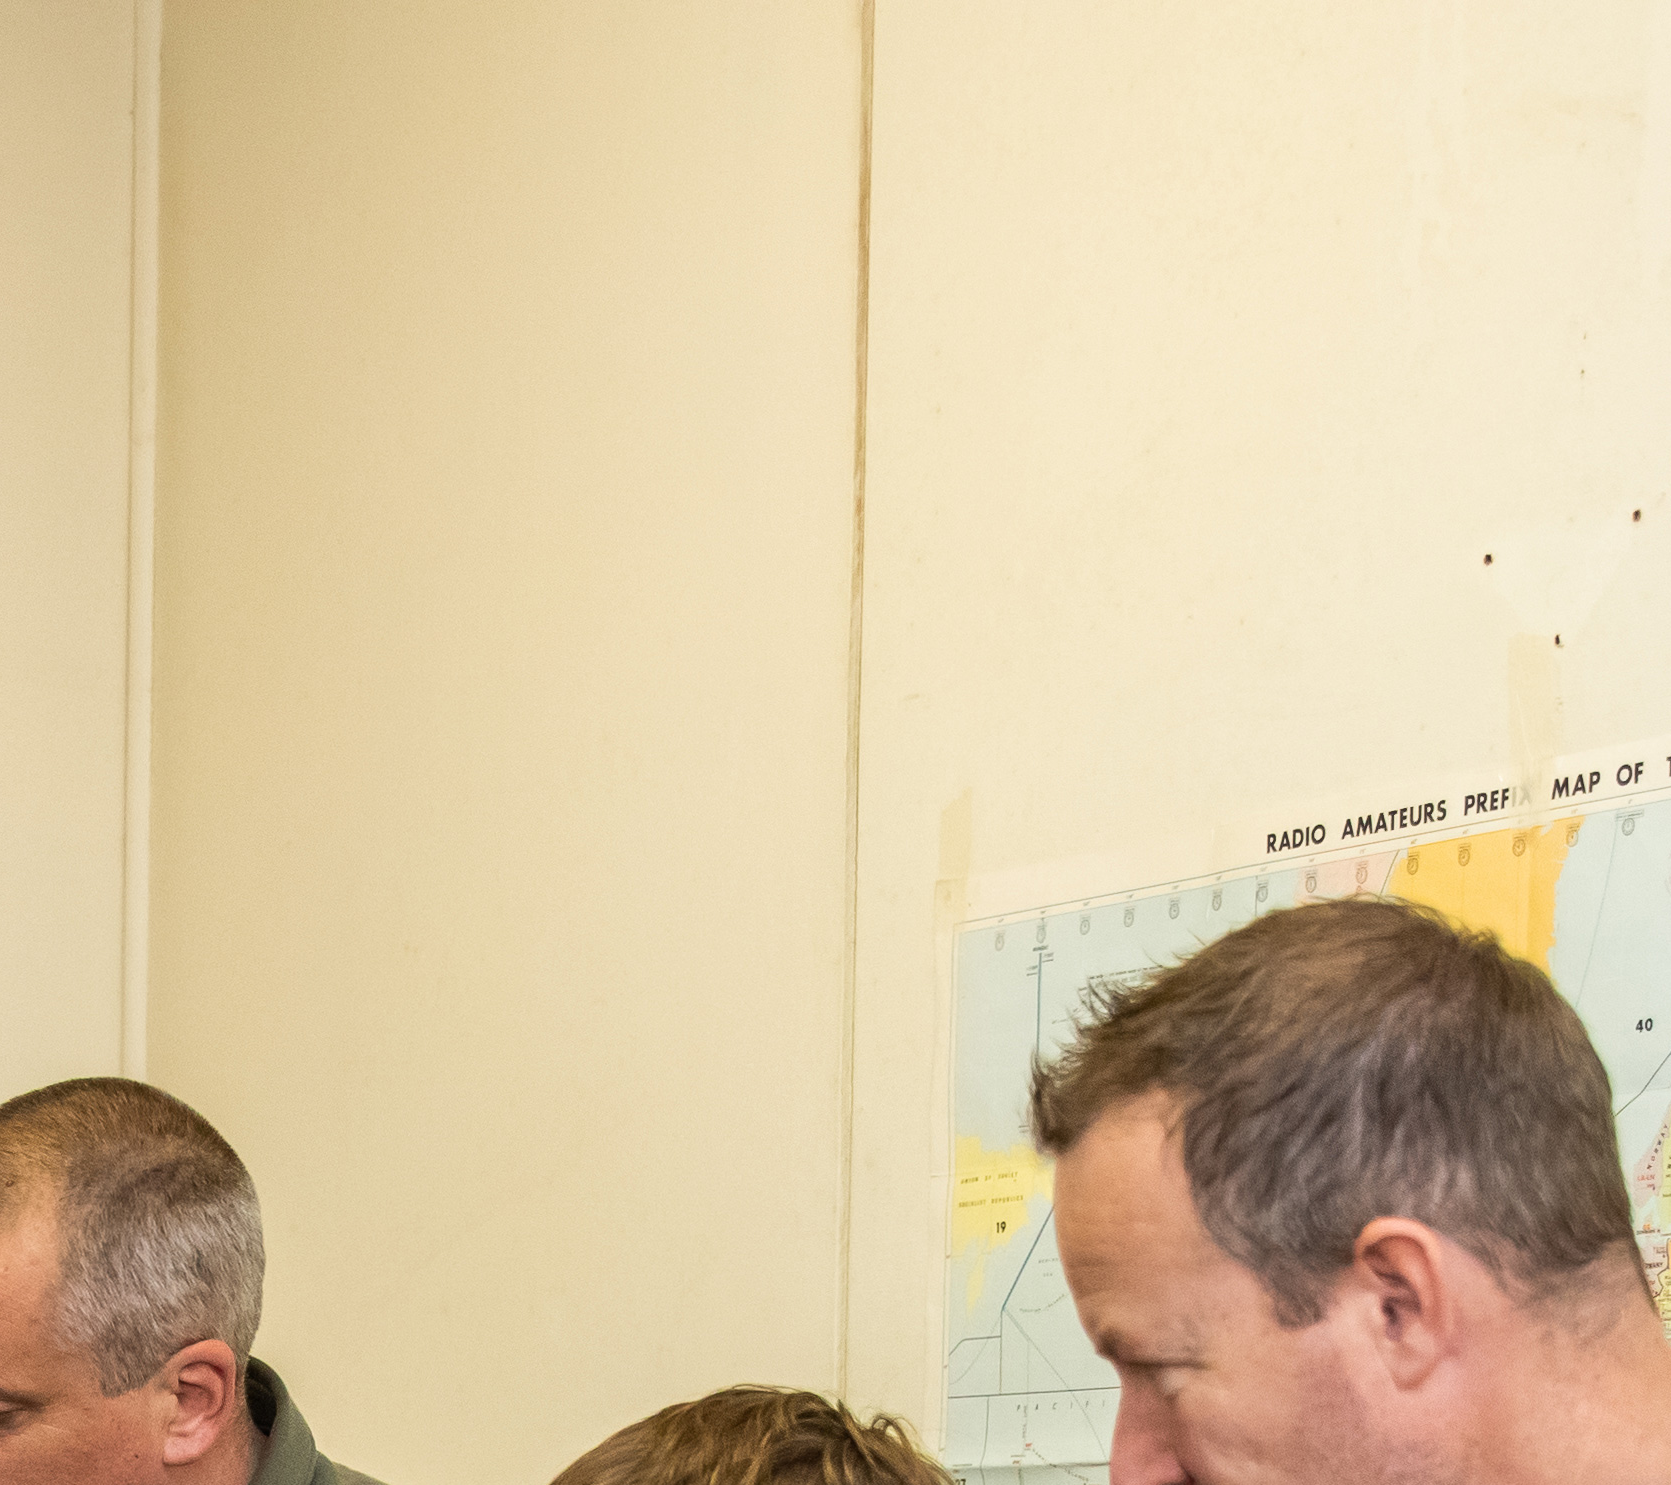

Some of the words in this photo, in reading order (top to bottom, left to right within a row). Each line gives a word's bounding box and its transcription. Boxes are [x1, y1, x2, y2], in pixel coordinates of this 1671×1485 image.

[1266, 823, 1327, 855] RADIO
[1341, 800, 1447, 840] AMATEURS
[1464, 781, 1533, 816] PREFIX
[1552, 770, 1601, 801] MAP
[1616, 761, 1645, 785] OF
[1636, 1018, 1653, 1033] 40
[995, 1221, 1007, 1234] 19
